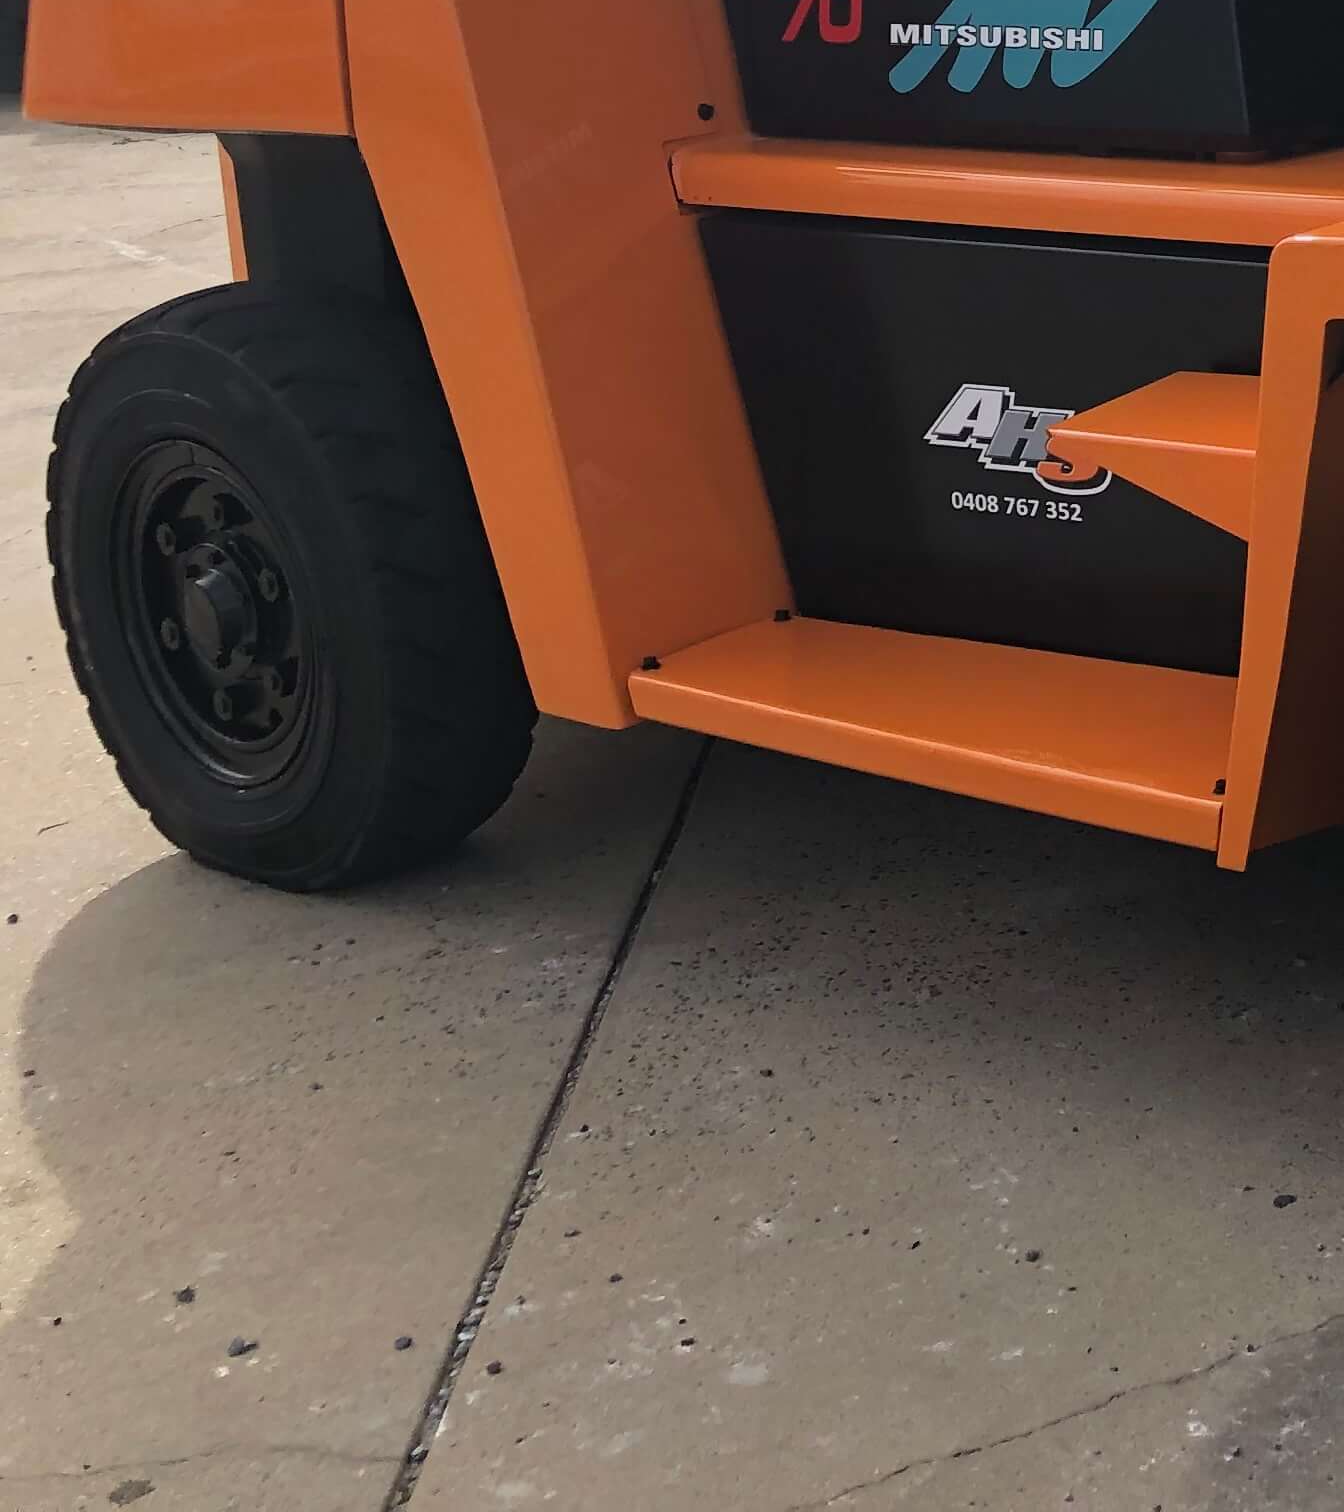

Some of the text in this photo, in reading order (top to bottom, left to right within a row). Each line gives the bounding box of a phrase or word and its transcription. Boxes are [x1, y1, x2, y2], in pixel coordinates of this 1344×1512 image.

[890, 23, 1104, 51] MITSUBISHI
[951, 491, 1083, 522] 0408 767 352
